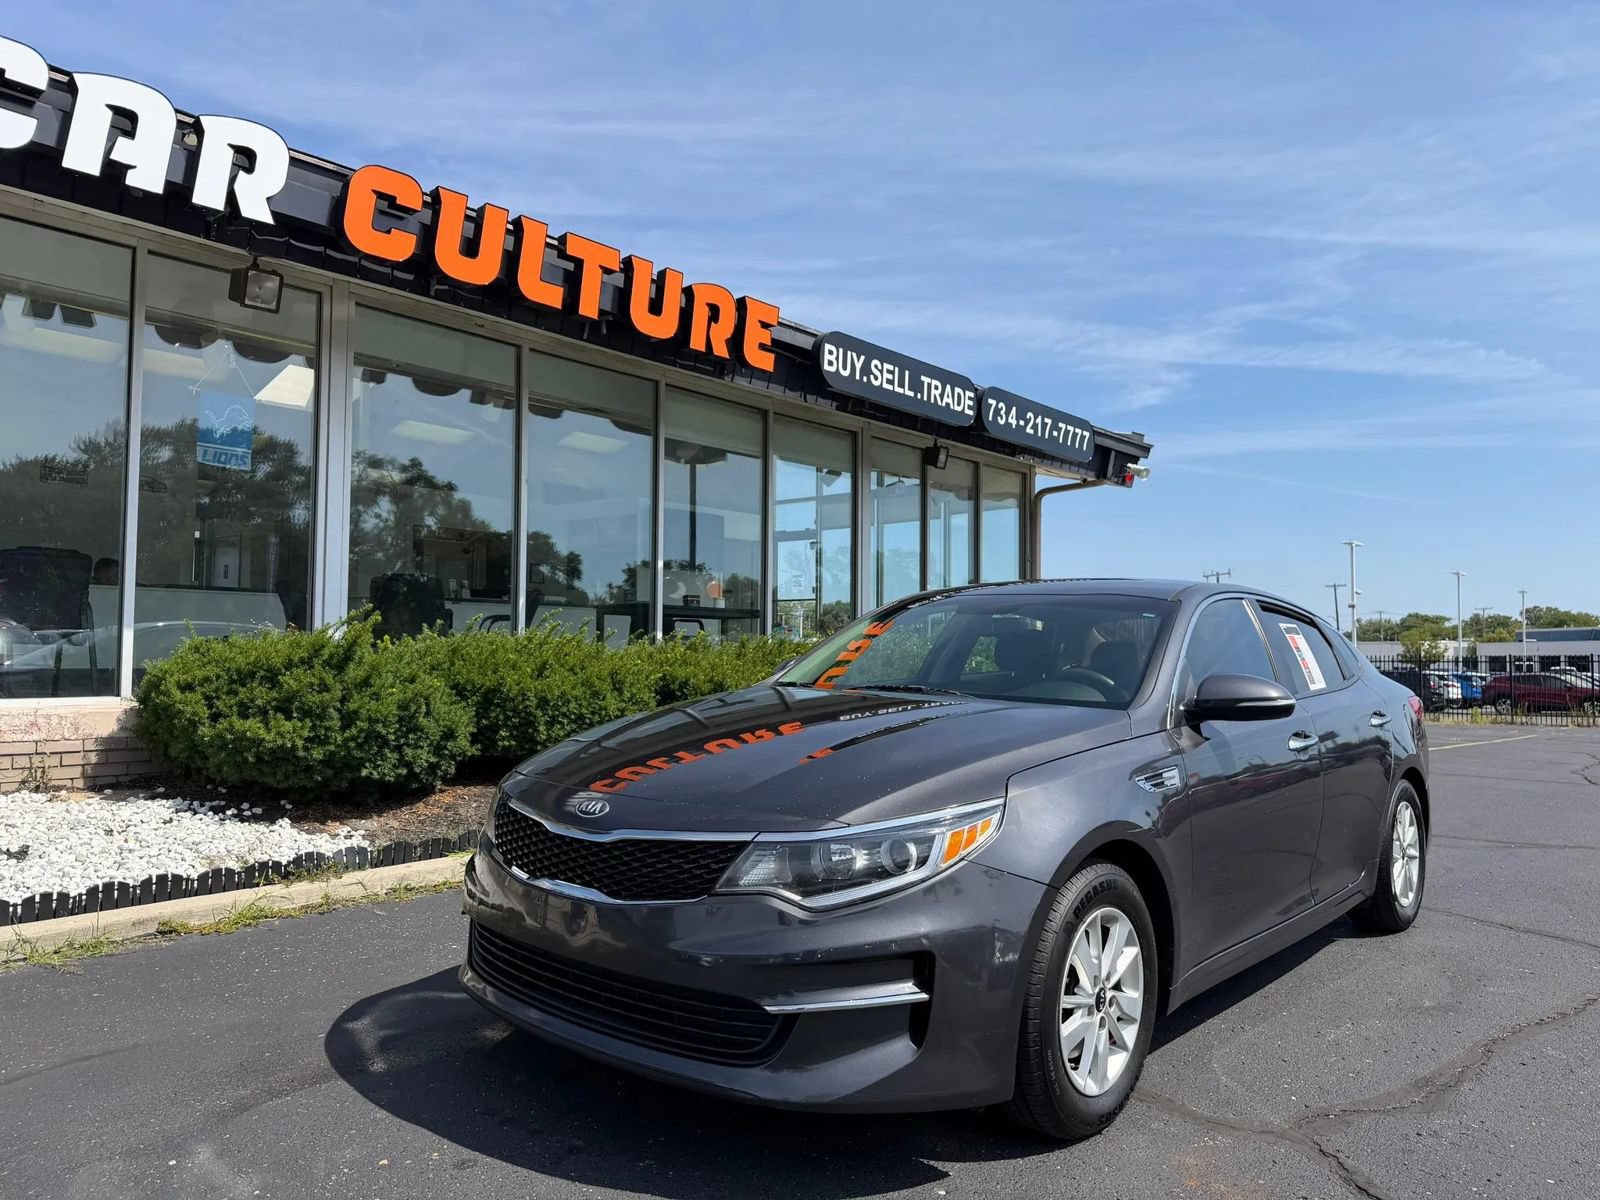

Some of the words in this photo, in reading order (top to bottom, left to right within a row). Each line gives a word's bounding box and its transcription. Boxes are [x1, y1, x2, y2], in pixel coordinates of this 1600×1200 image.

[343, 164, 781, 373] CULTURE
[987, 398, 1090, 451] 734-217-7777
[578, 800, 605, 815] KIA
[1072, 878, 1119, 920] PEGASUS
